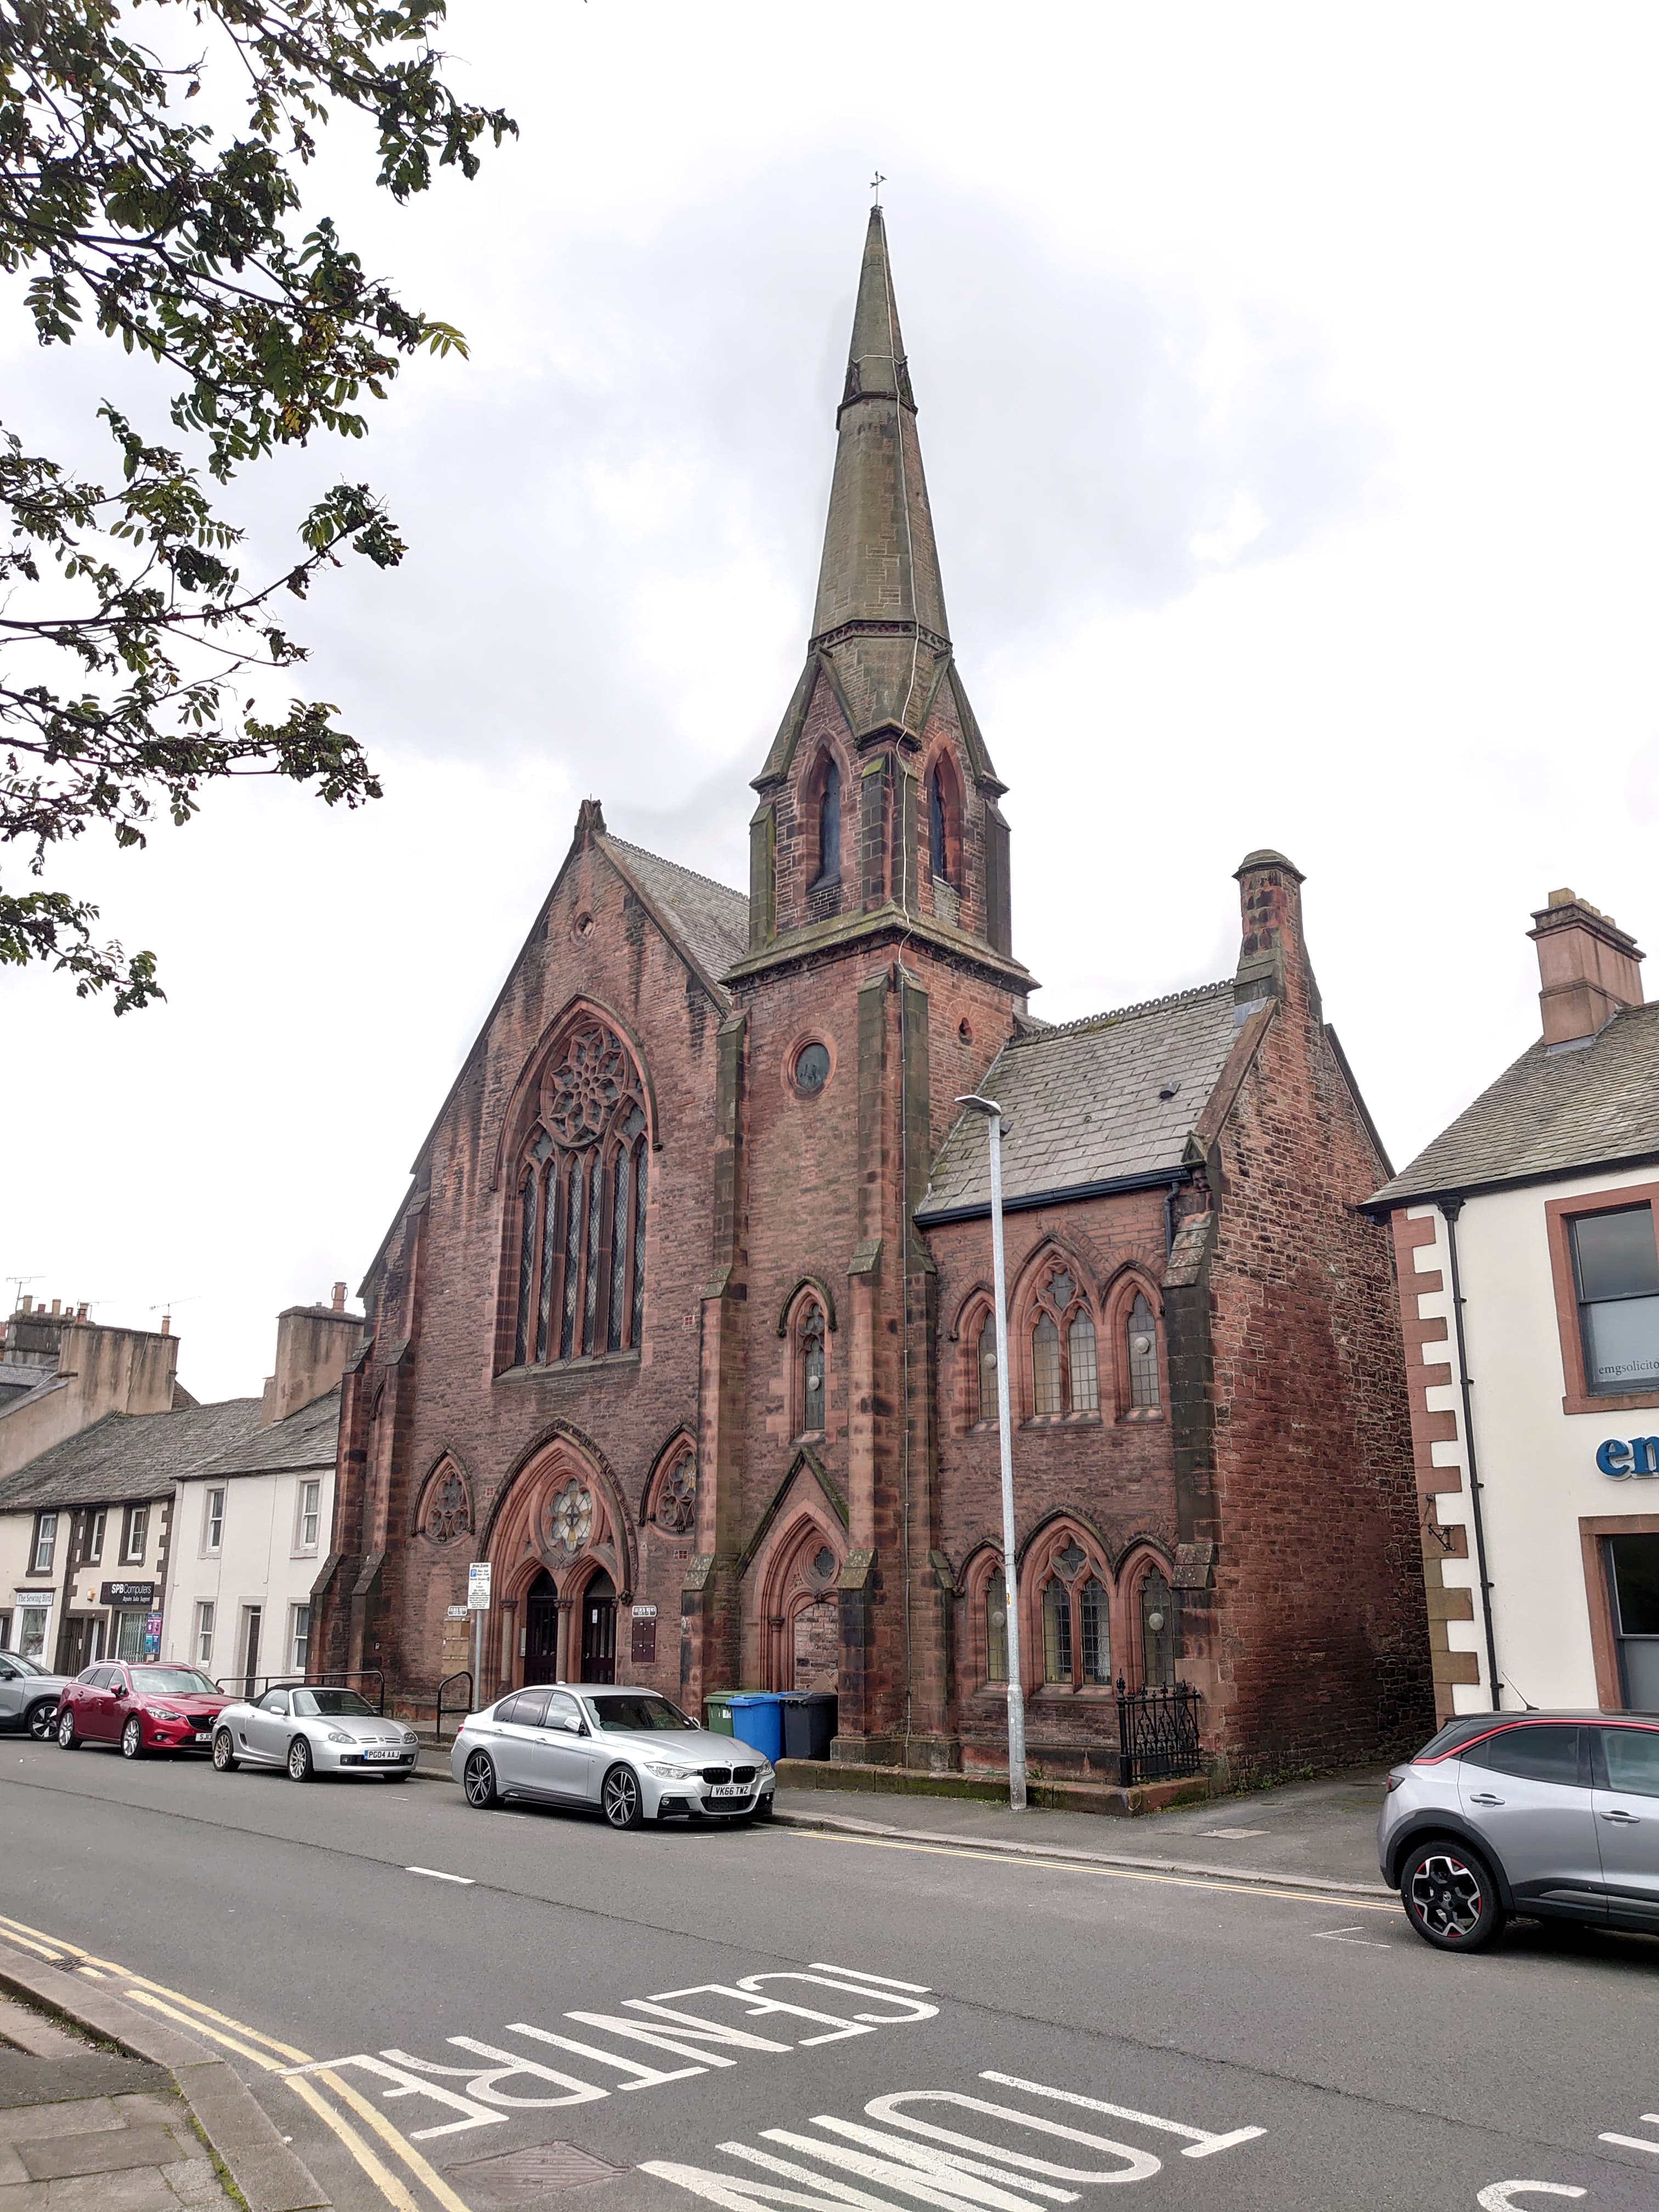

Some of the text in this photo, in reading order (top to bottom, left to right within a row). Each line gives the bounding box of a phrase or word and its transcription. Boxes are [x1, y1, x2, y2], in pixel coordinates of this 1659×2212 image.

[26, 1594, 41, 1604] Sewing
[715, 1786, 748, 1796] VK66 TWZ
[276, 1973, 939, 2138] CENTRE
[636, 2070, 1267, 2212] TOWN
